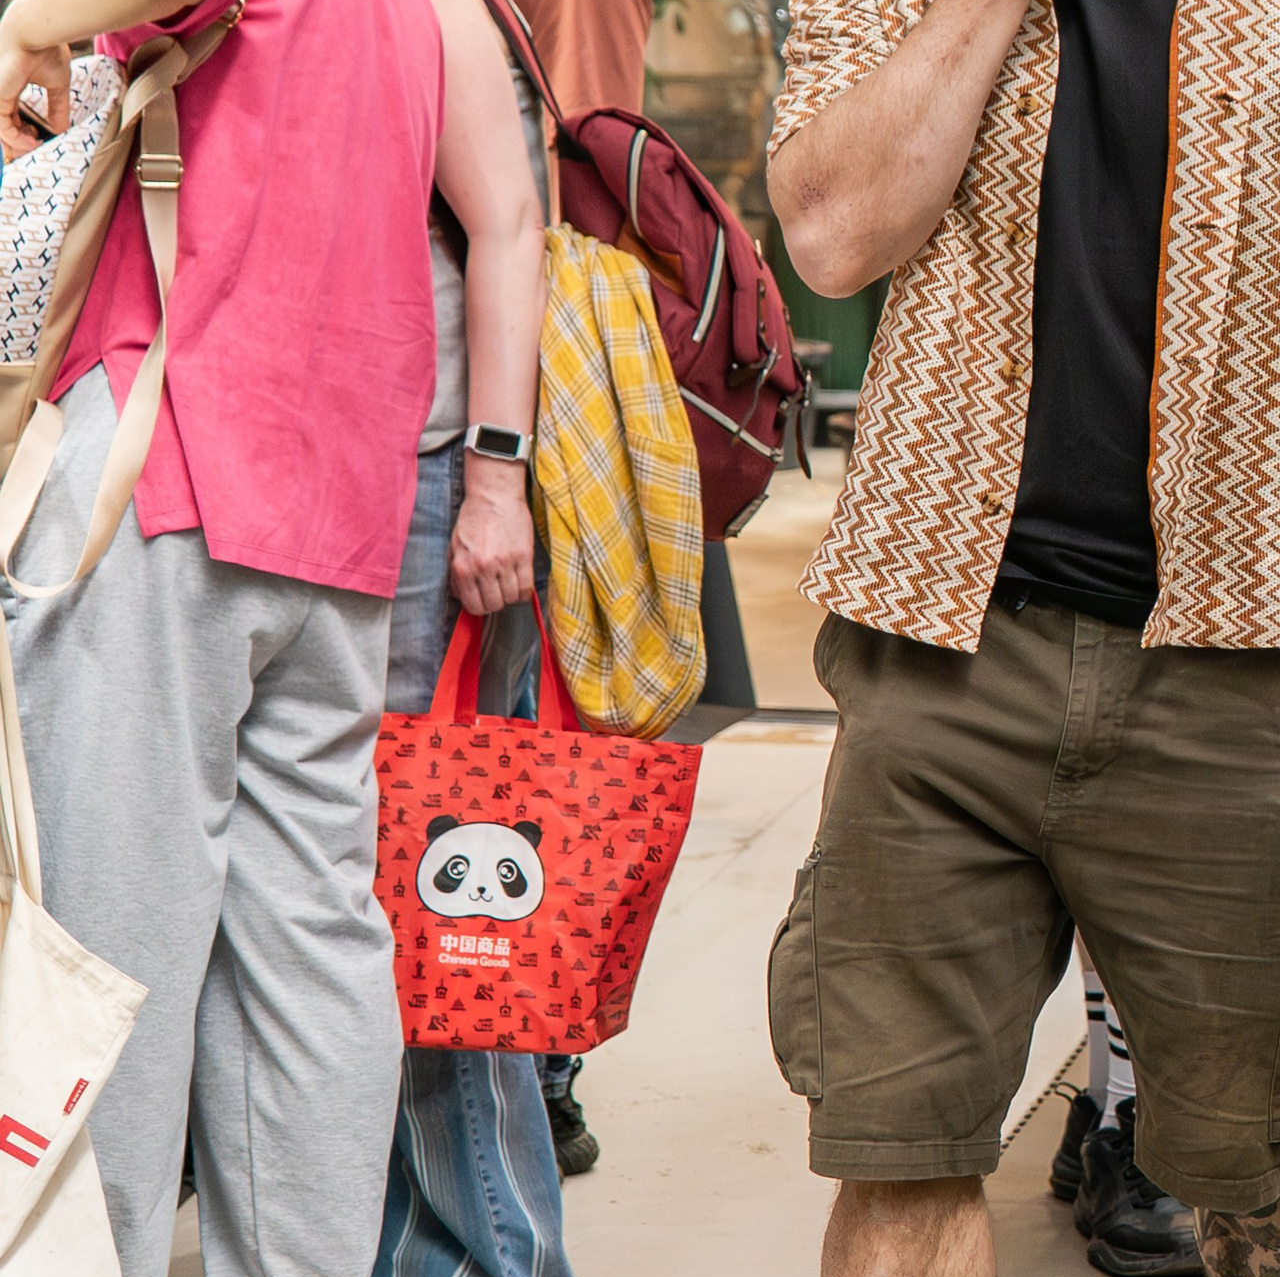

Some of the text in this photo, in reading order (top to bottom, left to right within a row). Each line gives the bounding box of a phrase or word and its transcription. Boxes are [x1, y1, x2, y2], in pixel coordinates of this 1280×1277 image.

[439, 934, 510, 956] 中国商品
[438, 953, 510, 968] Chinese Goods
